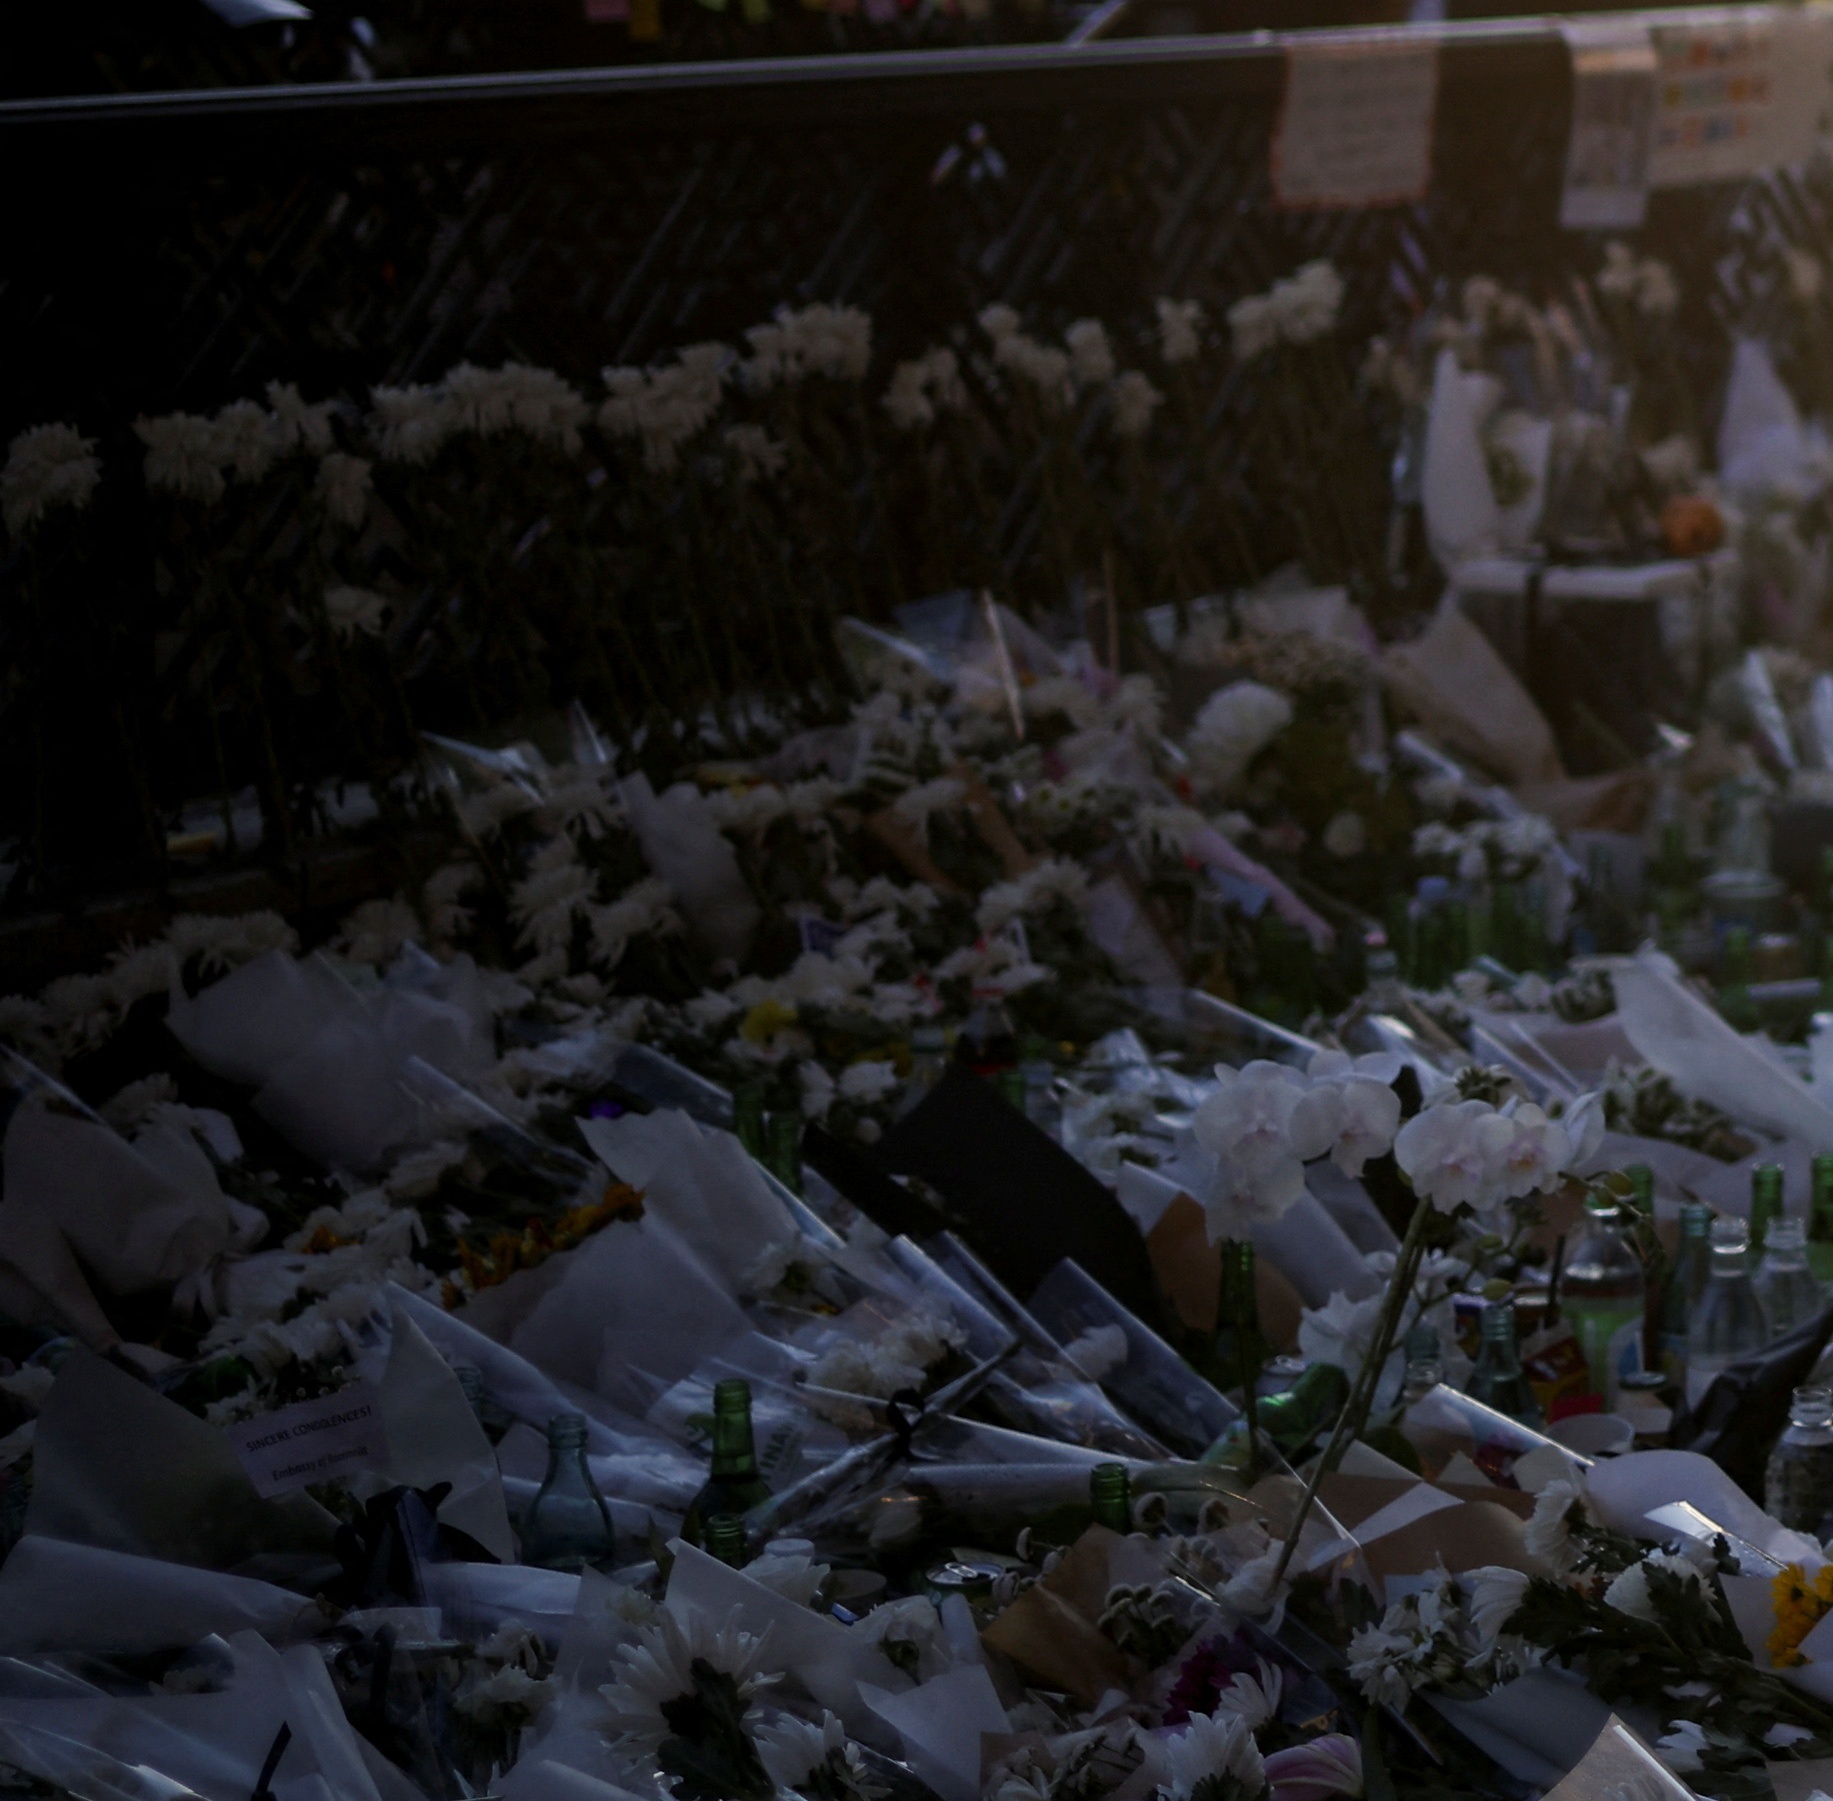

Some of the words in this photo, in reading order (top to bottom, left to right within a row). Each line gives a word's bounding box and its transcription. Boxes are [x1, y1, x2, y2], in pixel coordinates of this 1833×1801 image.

[246, 1429, 292, 1453] SINCERE
[292, 1405, 372, 1437] CONDOLENCES!
[272, 1461, 316, 1481] Embassy
